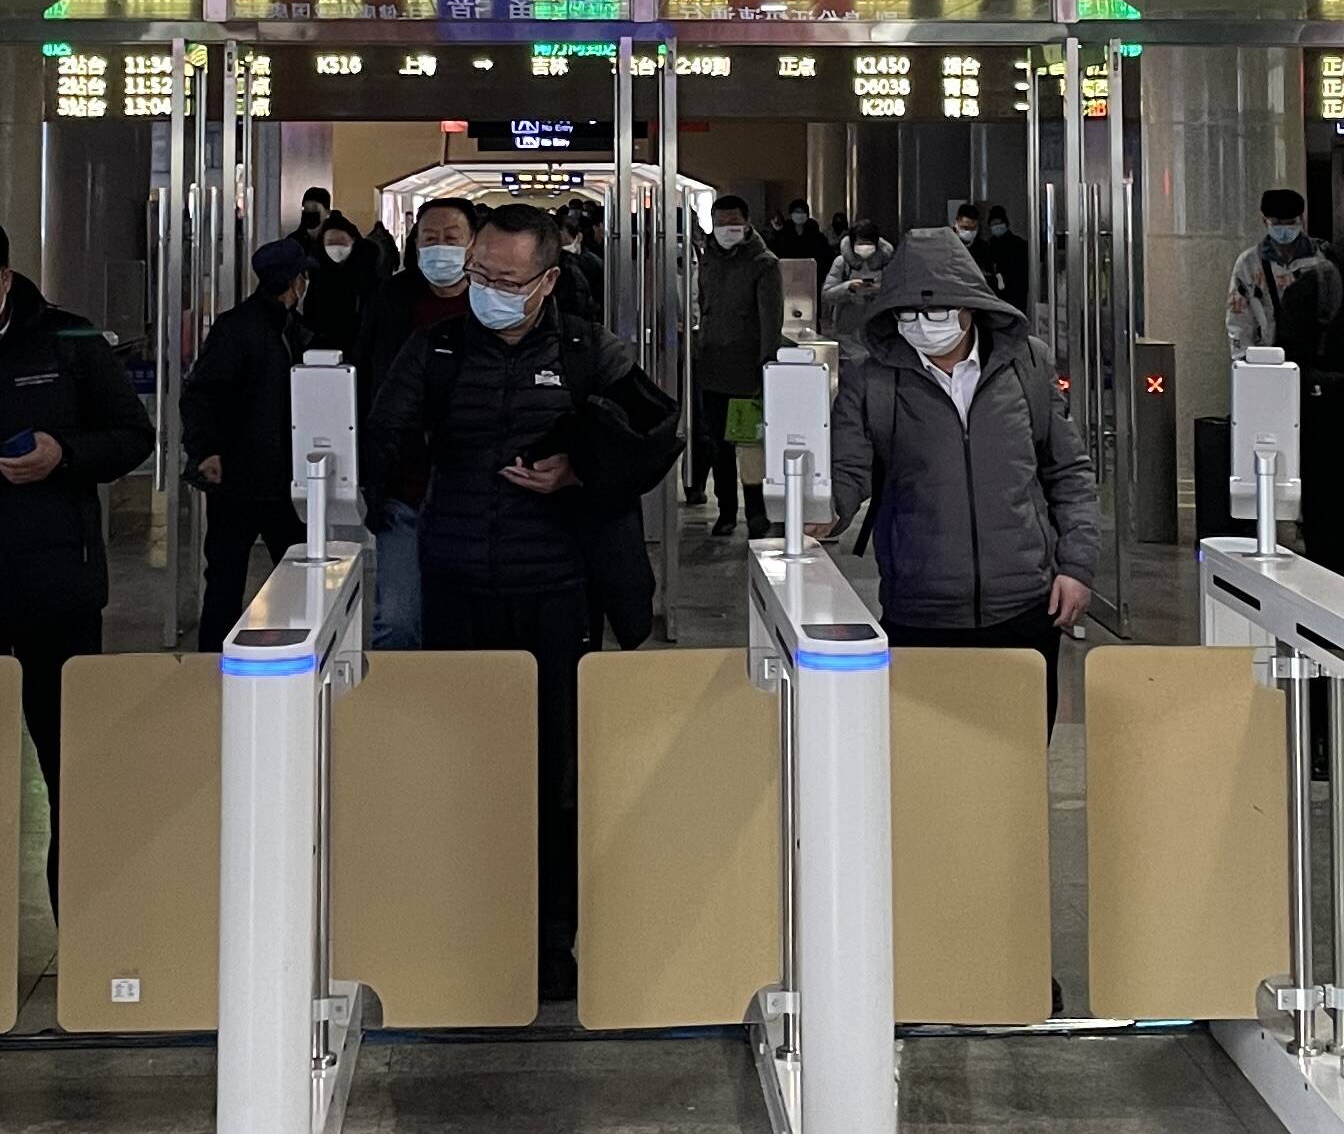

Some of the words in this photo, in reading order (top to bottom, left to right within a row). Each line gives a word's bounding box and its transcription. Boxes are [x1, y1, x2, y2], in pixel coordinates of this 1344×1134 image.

[316, 55, 362, 74] K516
[398, 54, 437, 76] 上海
[532, 55, 569, 76] 吉林
[778, 57, 816, 76] 正点
[855, 56, 911, 75] K1450
